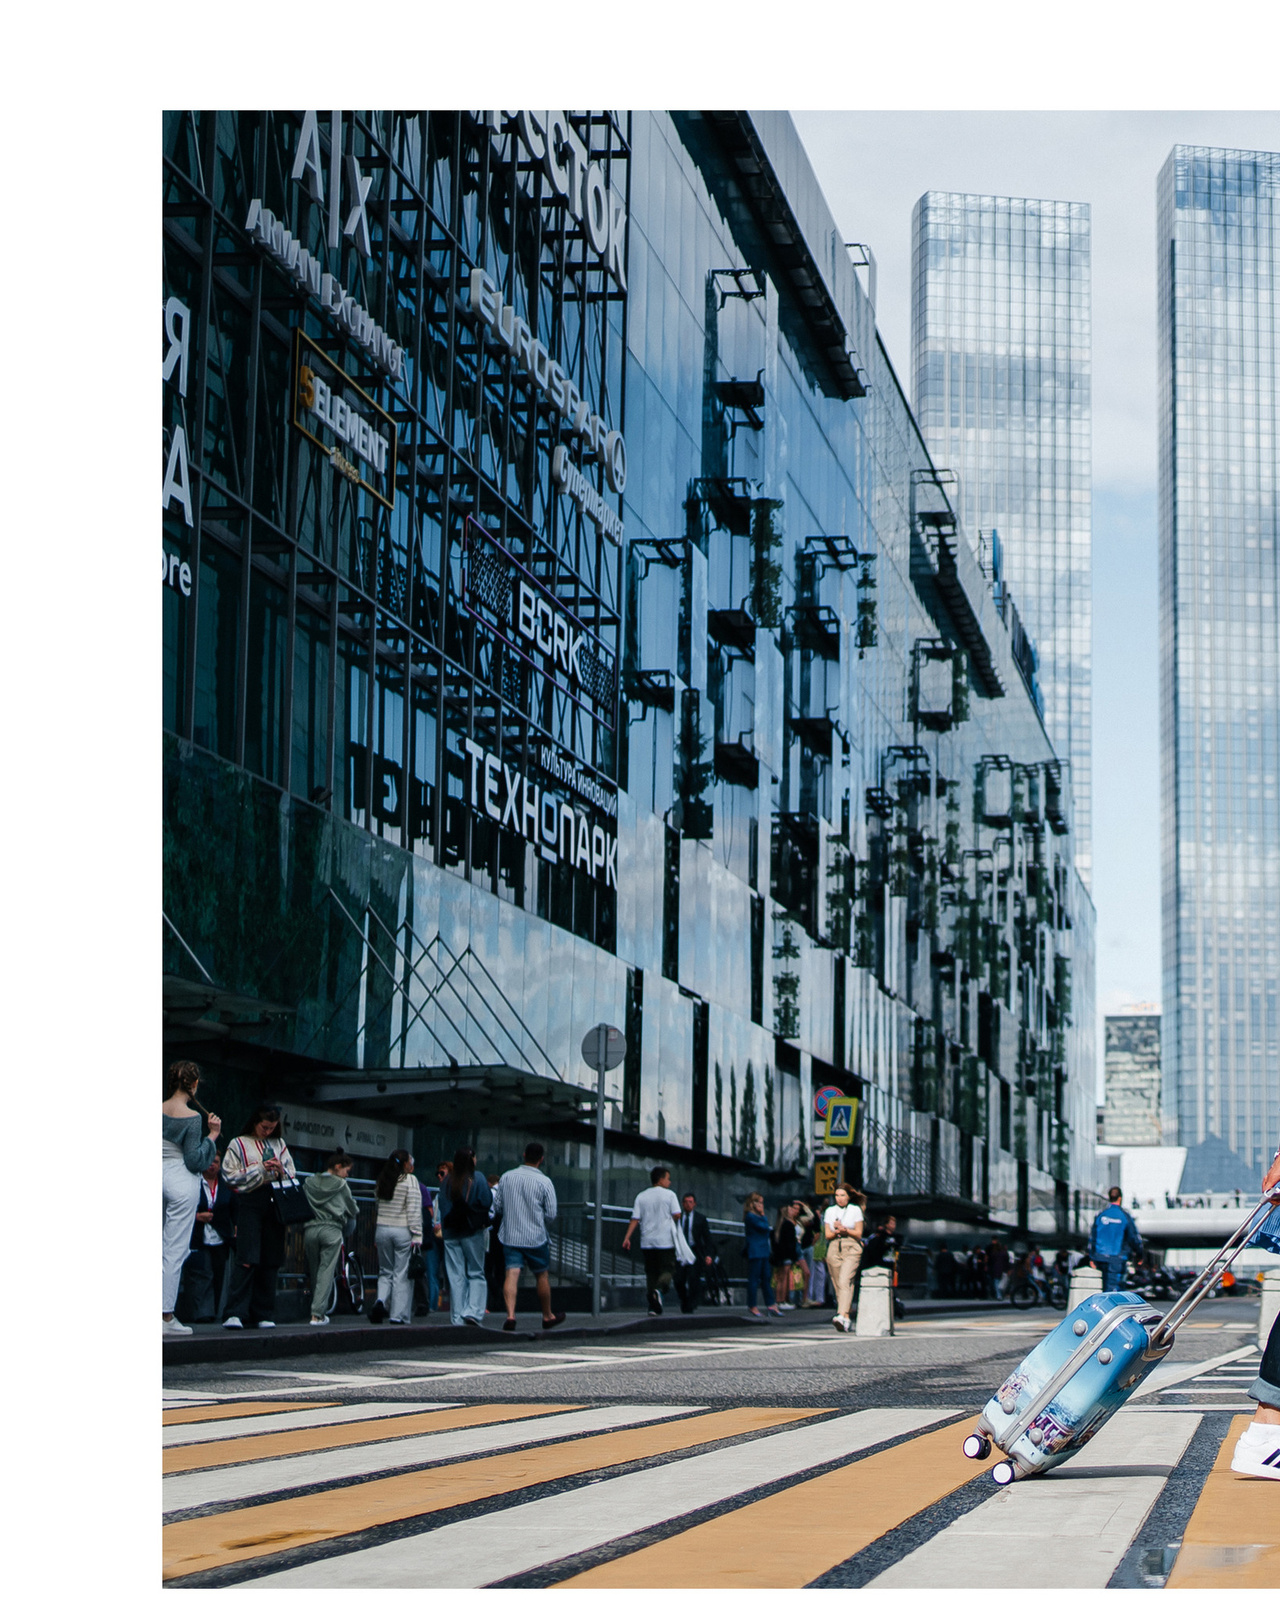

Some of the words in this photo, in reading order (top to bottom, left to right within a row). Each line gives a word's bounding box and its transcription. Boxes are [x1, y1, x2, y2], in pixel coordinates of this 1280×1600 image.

[245, 199, 321, 295] ARMANI
[320, 273, 406, 382] EXCHANGE
[471, 268, 611, 463] EUROSPAR
[465, 737, 618, 893] ТЕХНОПАРК
[541, 744, 577, 791] КУЛЬТУРА
[577, 771, 617, 819] ИННОВАЦИЙ
